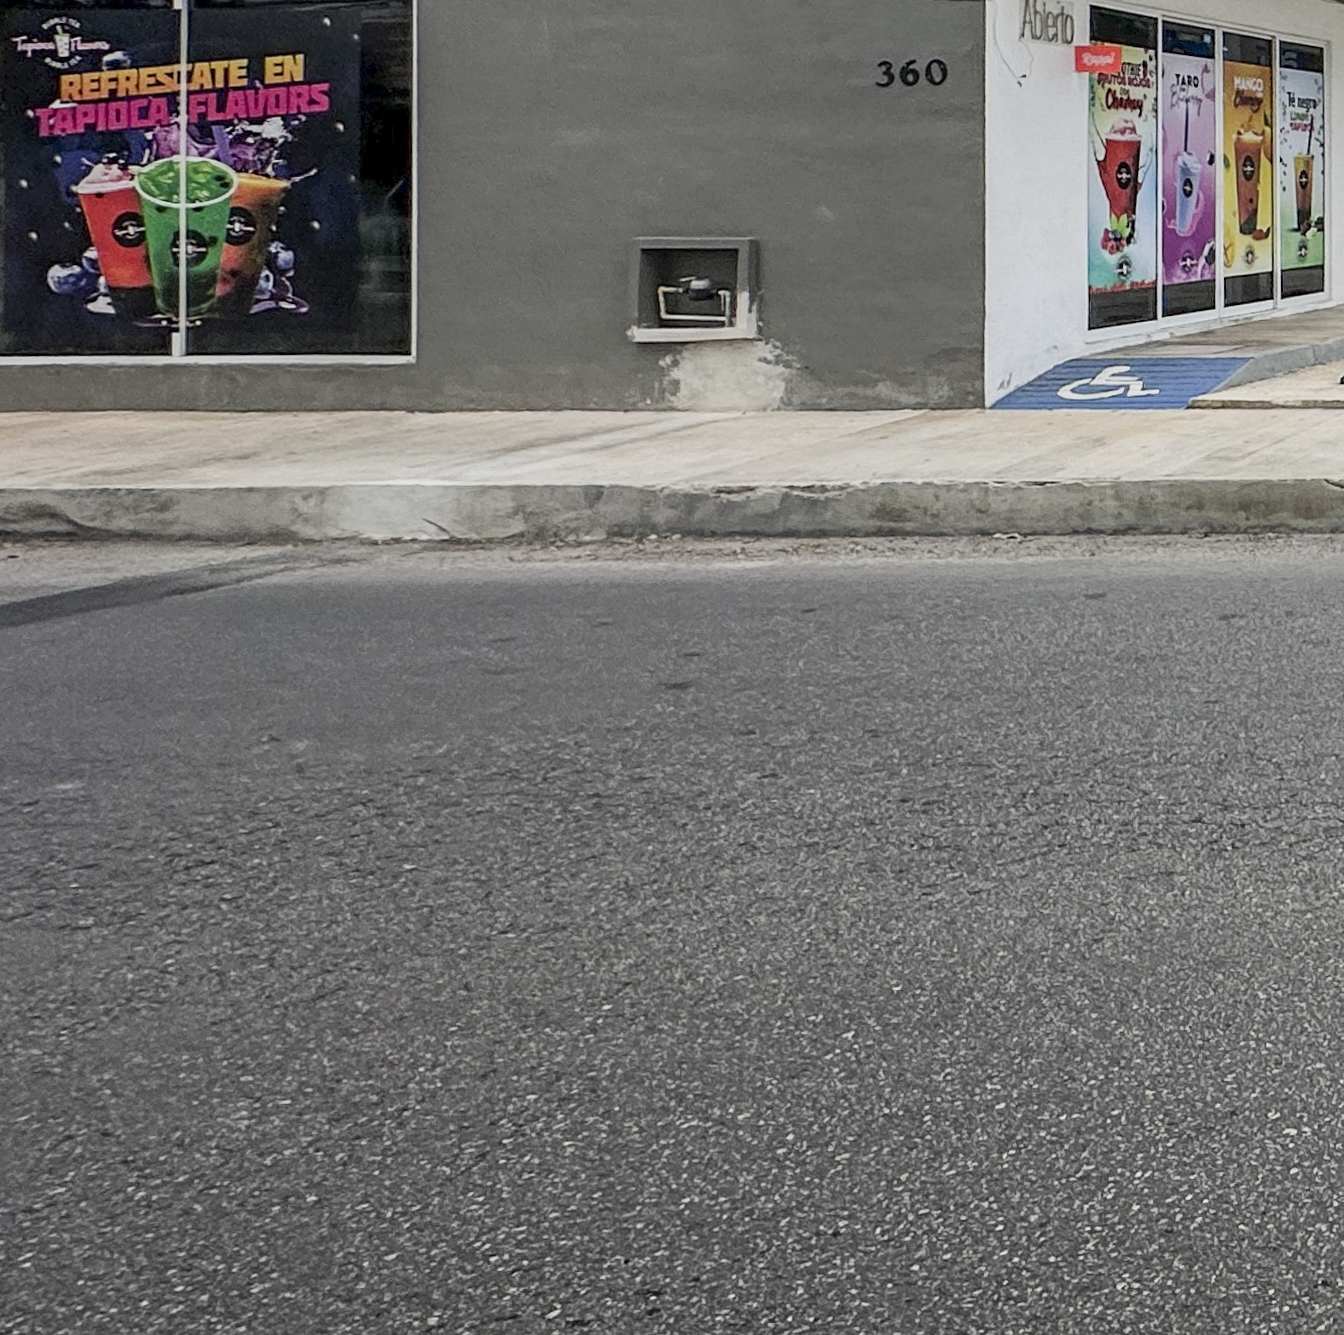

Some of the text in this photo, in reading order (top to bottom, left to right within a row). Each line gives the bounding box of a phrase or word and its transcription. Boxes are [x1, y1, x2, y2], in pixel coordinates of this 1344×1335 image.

[263, 53, 305, 85] EN
[875, 58, 949, 88] 360
[1175, 73, 1200, 88] TARO
[1233, 75, 1265, 92] MANGO
[34, 82, 330, 138] TAPIOCA FLAVORS
